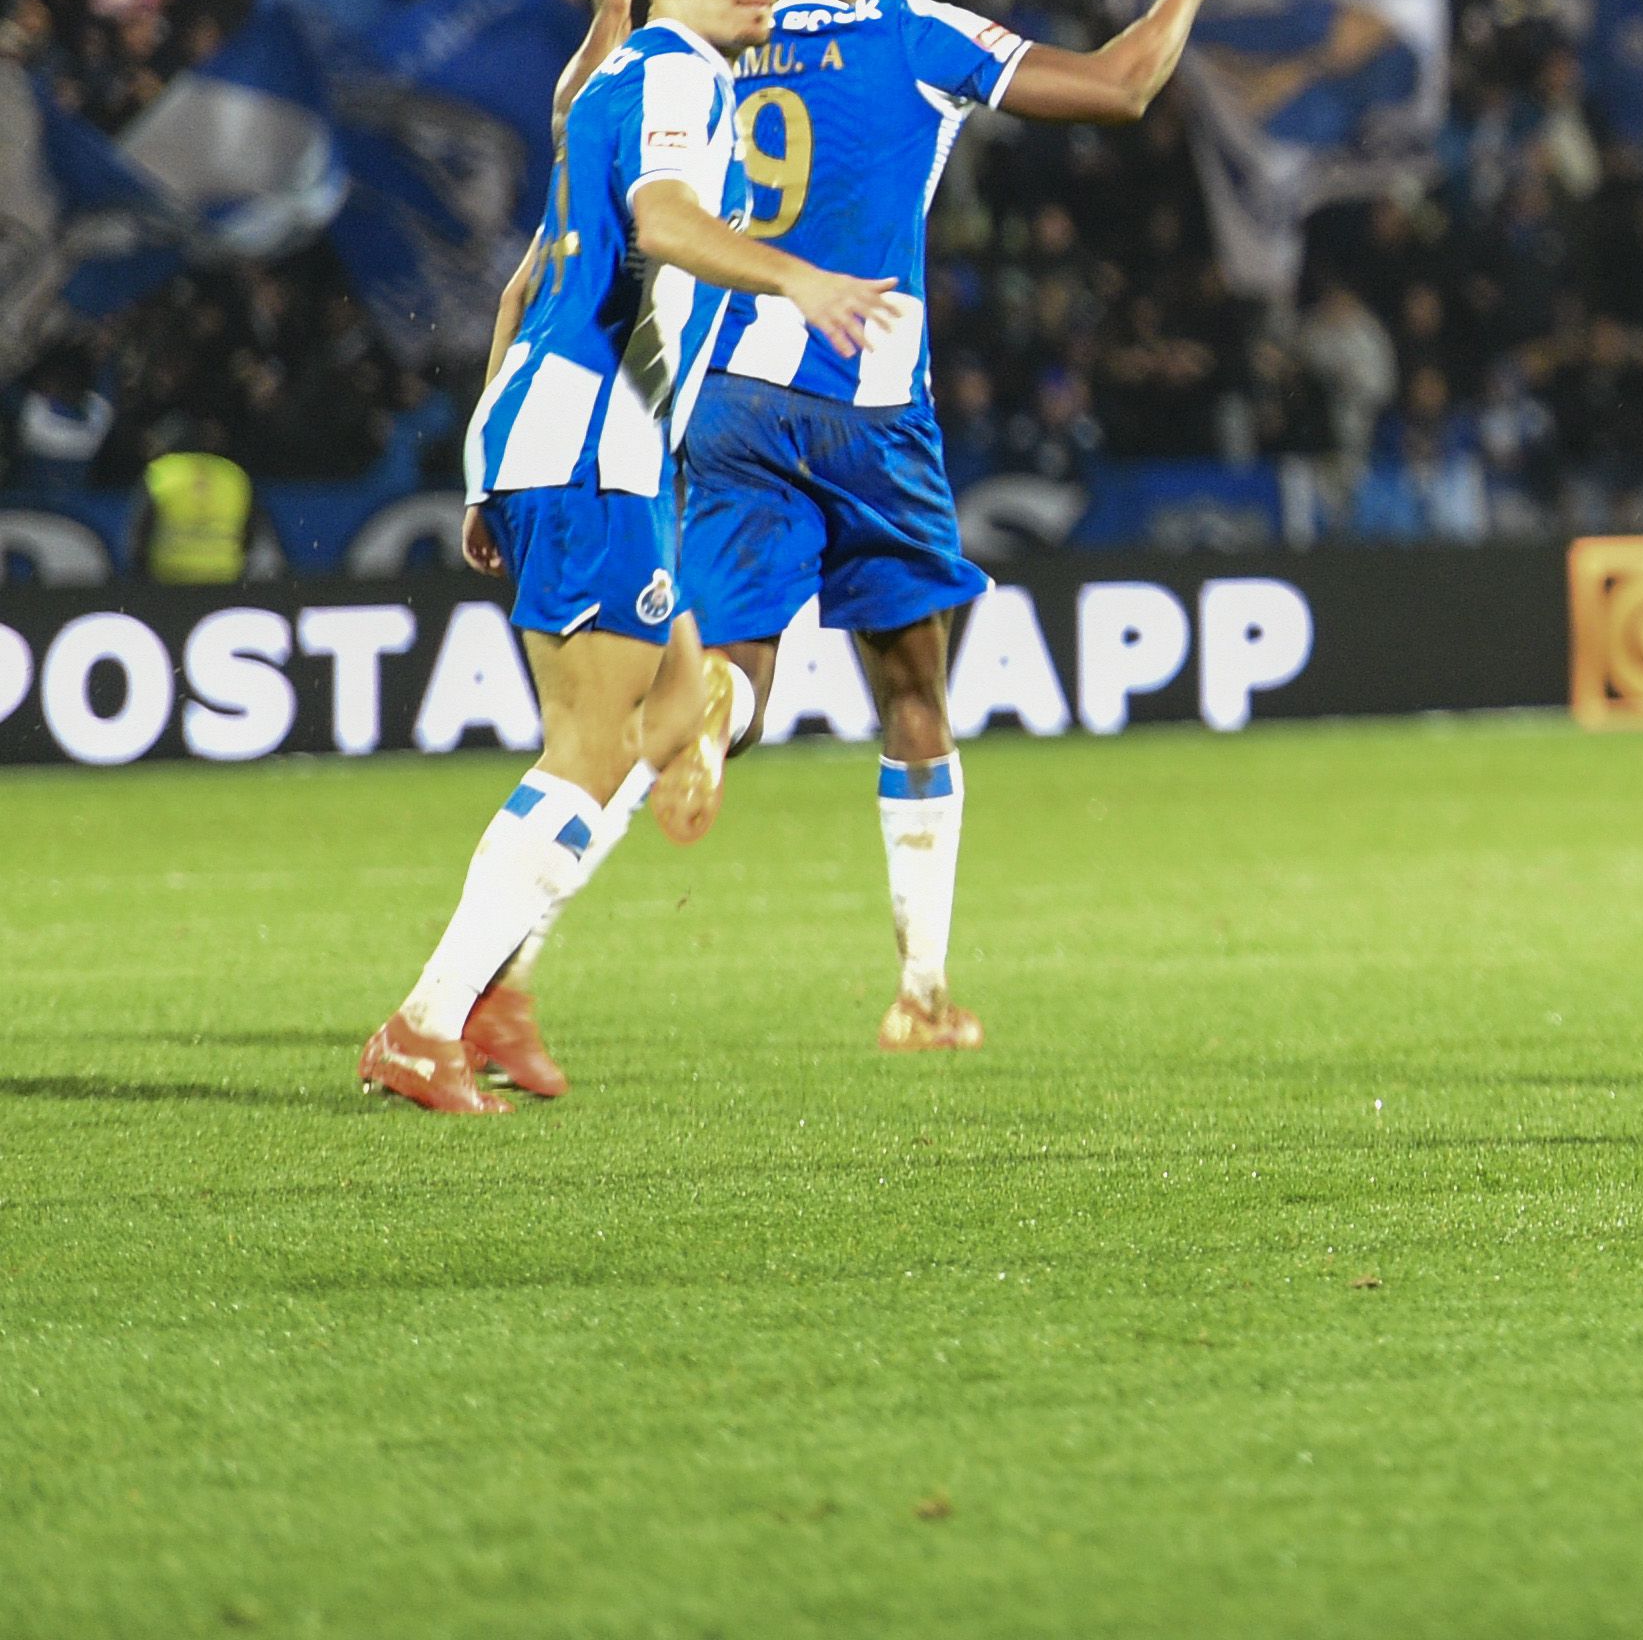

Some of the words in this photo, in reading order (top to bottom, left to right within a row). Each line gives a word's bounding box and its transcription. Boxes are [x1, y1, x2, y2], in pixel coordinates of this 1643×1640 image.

[735, 85, 815, 240] 9
[0, 601, 545, 765] OSTA
[948, 576, 1315, 739] APP
